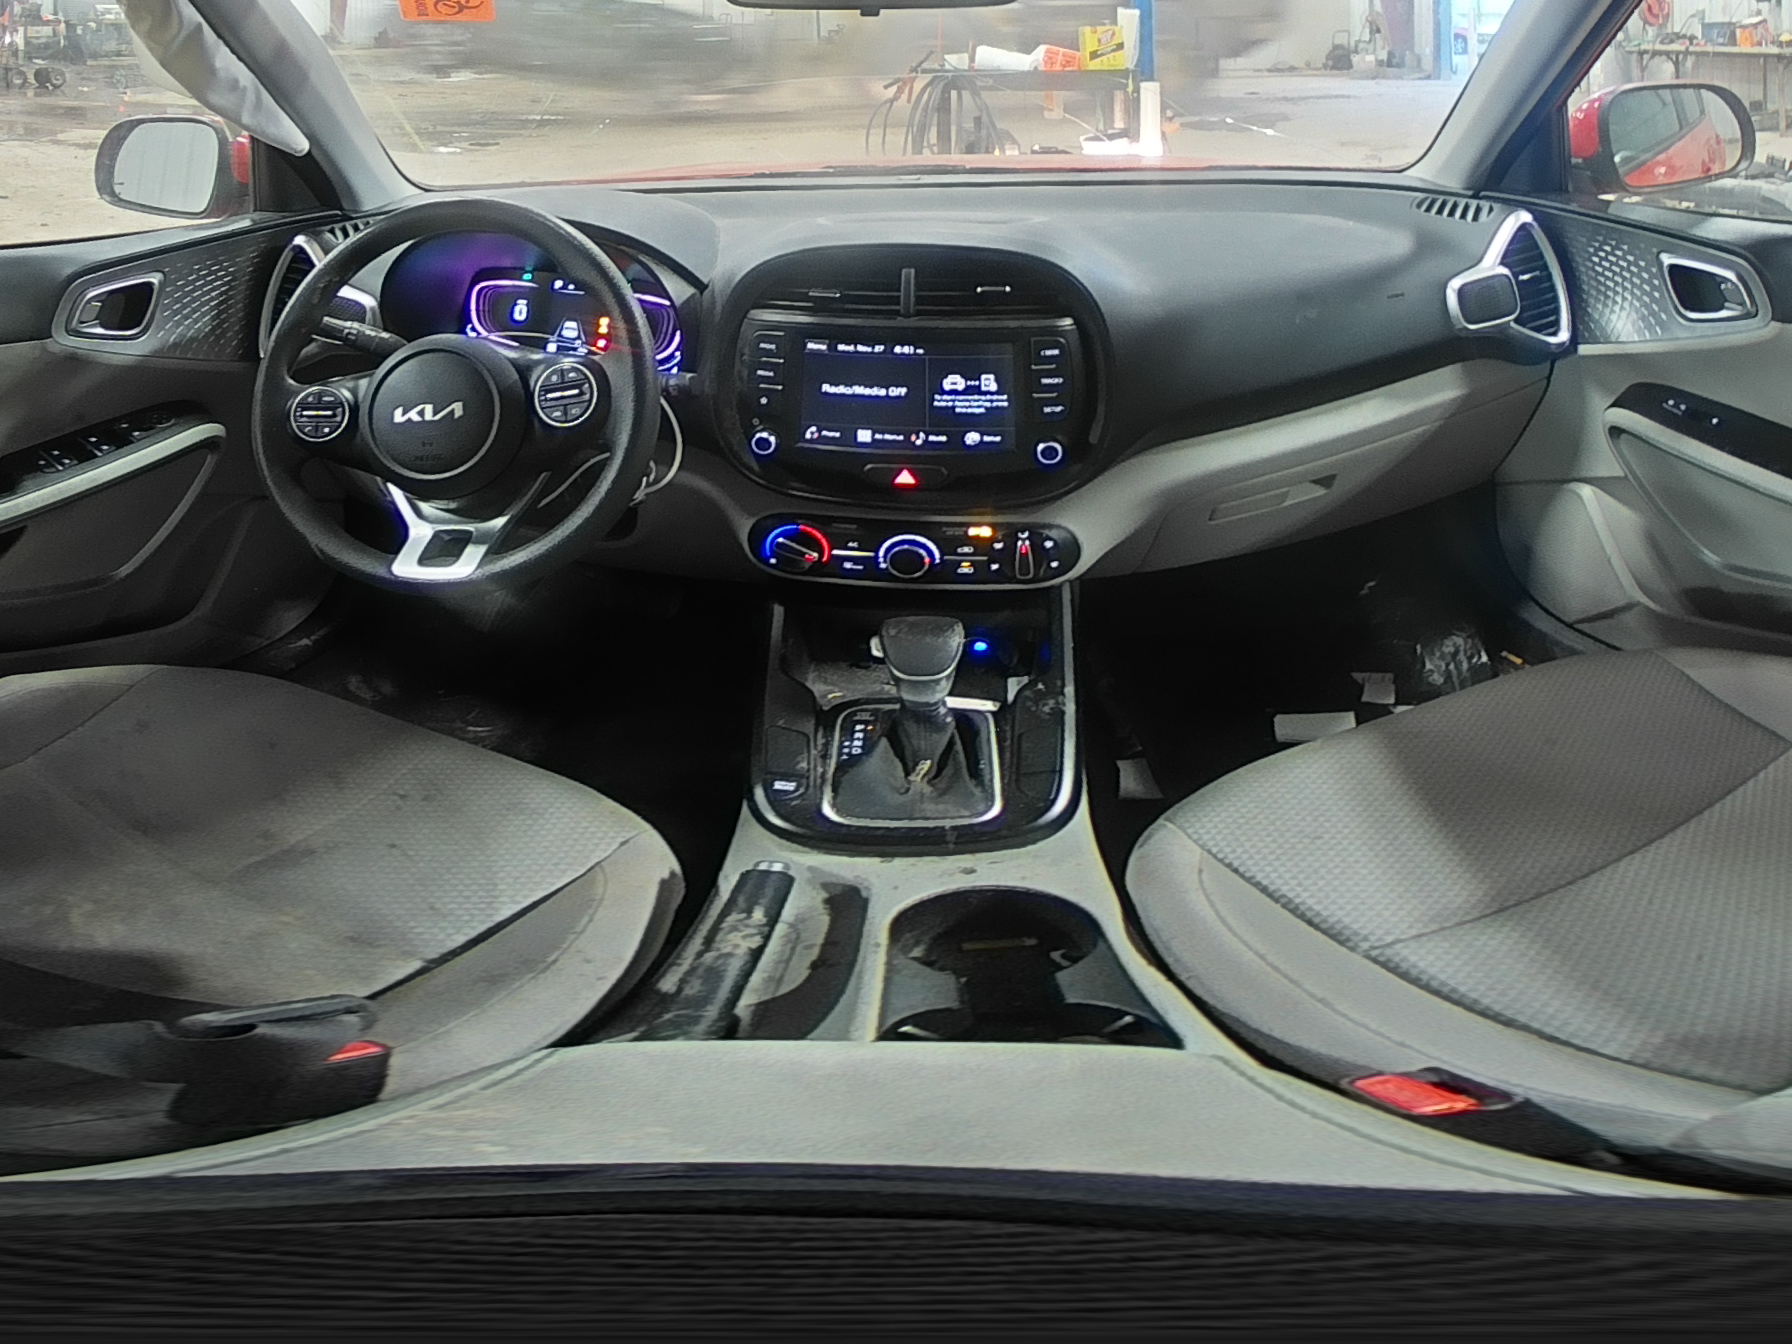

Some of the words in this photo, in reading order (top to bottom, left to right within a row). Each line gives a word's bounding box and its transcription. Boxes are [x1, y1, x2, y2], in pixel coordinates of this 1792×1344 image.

[821, 383, 887, 397] Radio/Media
[888, 386, 908, 397] Off
[393, 401, 464, 424] KIA
